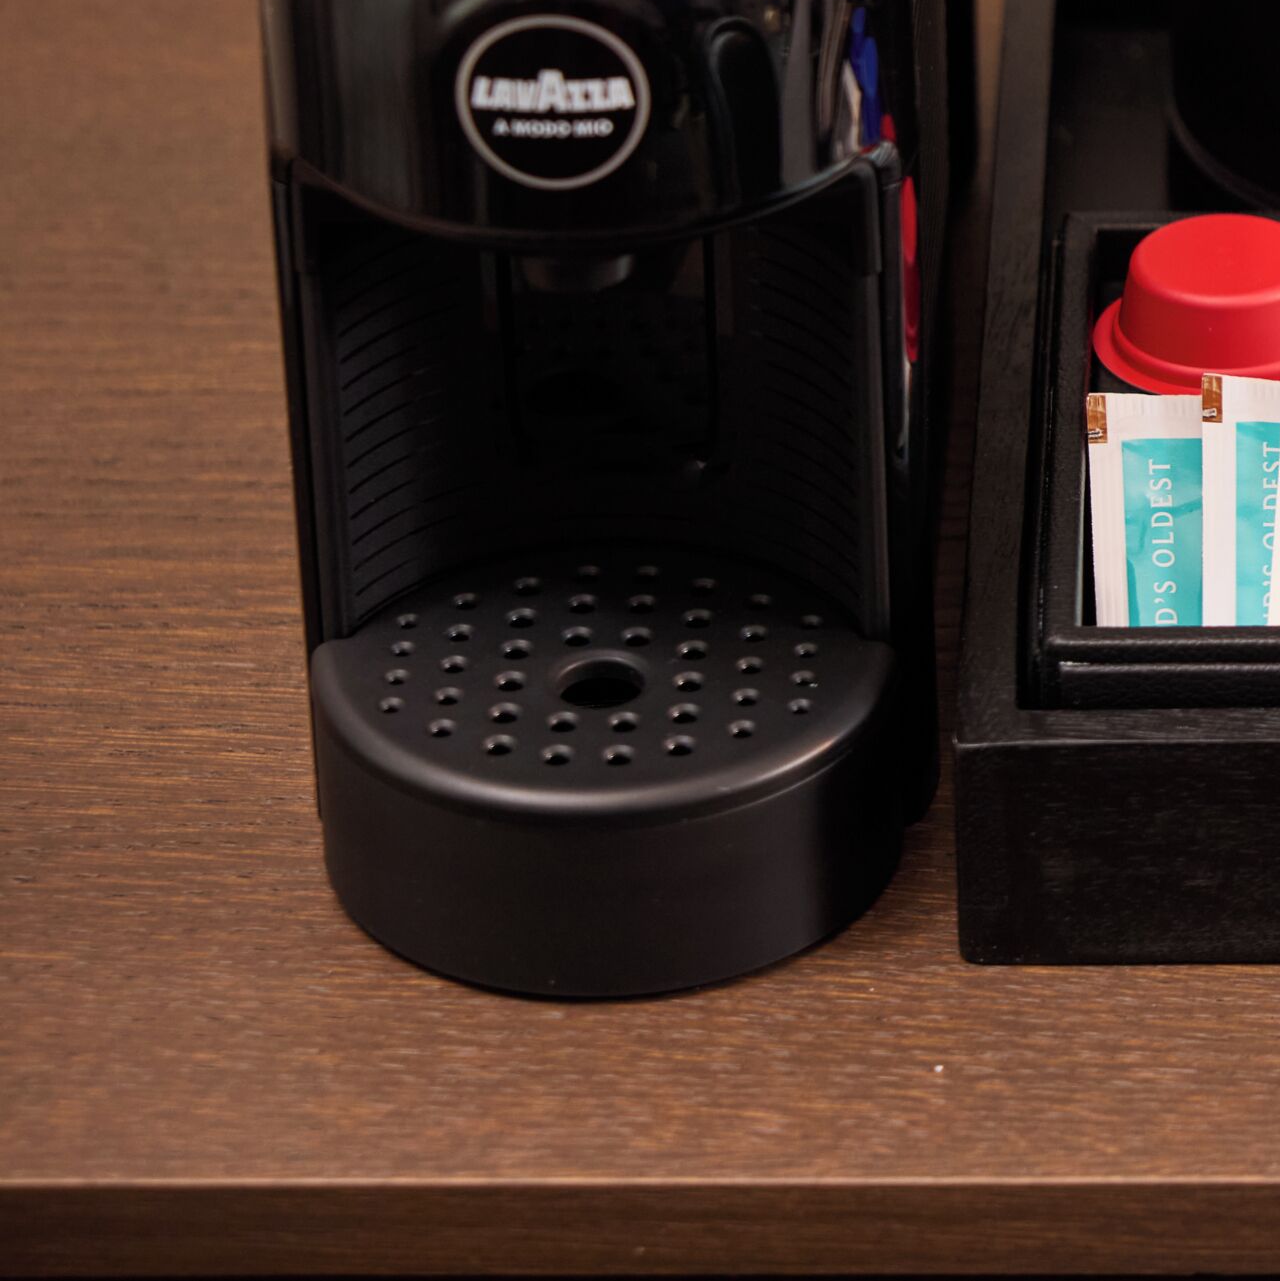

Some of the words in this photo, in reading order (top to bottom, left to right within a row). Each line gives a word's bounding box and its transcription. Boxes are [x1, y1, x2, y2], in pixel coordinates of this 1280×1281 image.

[470, 69, 636, 113] LAVAZZA
[493, 118, 510, 136] A
[511, 119, 572, 138] MODO
[573, 119, 614, 137] MIO
[1148, 458, 1177, 568] OLDEST
